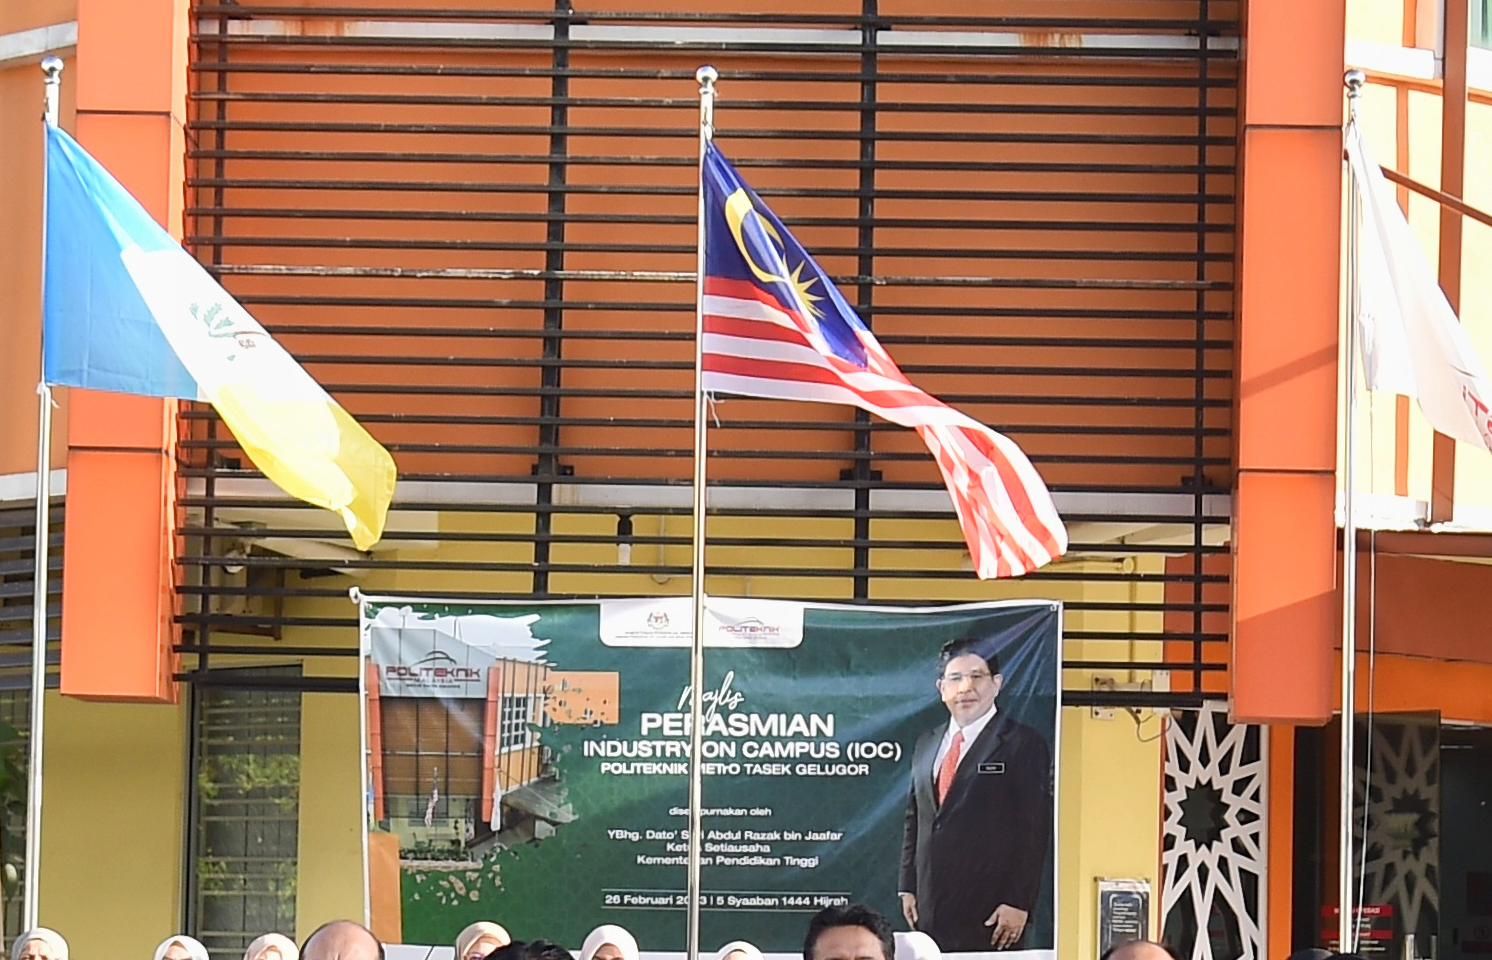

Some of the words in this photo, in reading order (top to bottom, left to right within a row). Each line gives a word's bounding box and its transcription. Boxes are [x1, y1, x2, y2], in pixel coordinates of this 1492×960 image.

[386, 666, 481, 678] POLITEKNIK
[583, 740, 693, 758] INDUSTRY
[701, 741, 736, 758] ON
[742, 741, 840, 759] CAMPUS
[847, 741, 902, 761] (IOC)
[600, 762, 689, 775] POLITEKNIK
[743, 763, 792, 776] TASEK
[795, 764, 870, 776] GELUGOR
[749, 806, 772, 816] oleh
[607, 829, 643, 842] YBhg.
[646, 829, 678, 840] Dato'
[707, 830, 741, 840] Abdul
[744, 830, 781, 840] Razak
[783, 831, 802, 841] bin
[804, 831, 843, 841] Jaafar
[705, 842, 771, 852] Setiausaha
[716, 855, 781, 866] Pendidikan
[783, 856, 820, 868] Tinggi
[623, 894, 673, 905] Februari
[675, 895, 708, 905] 203
[727, 895, 779, 908] Syaaban
[782, 896, 811, 906] 1444
[813, 896, 849, 908] Hijrah
